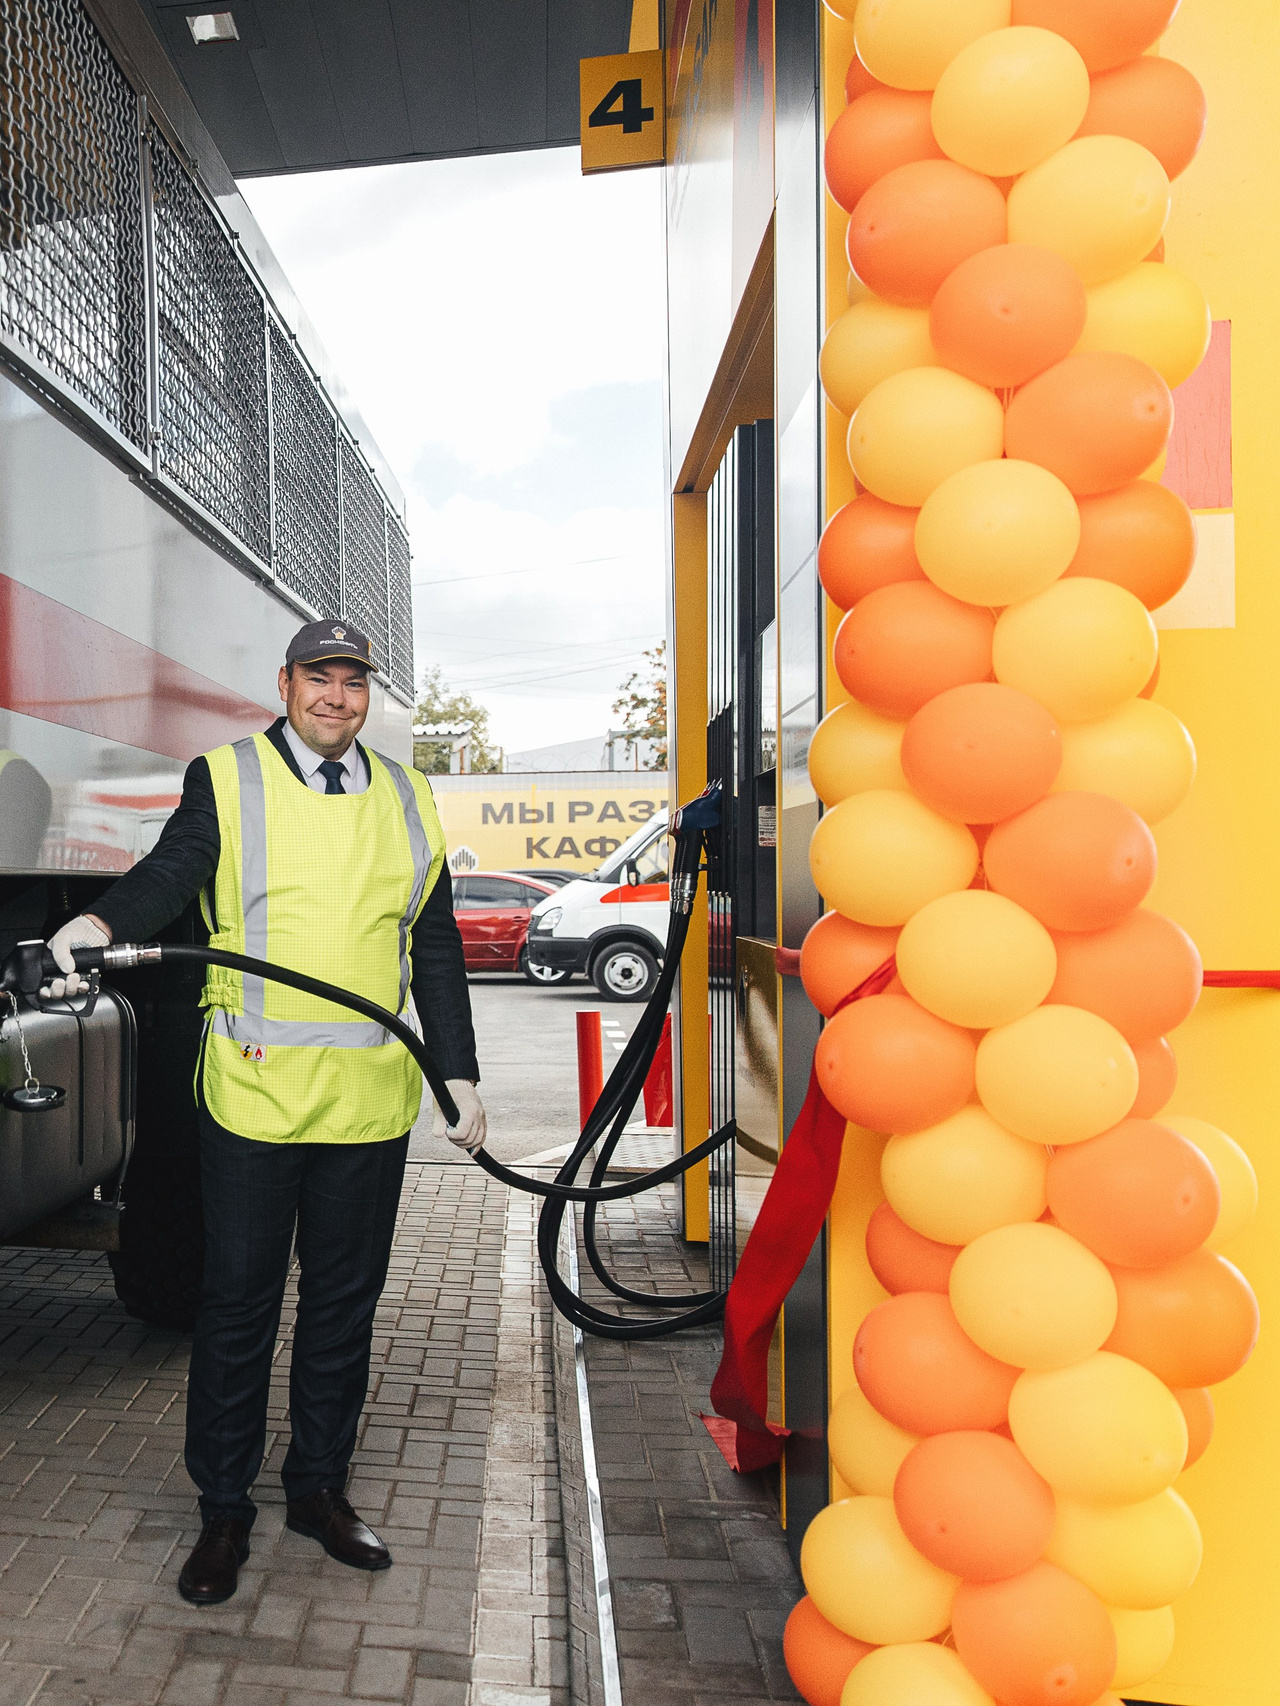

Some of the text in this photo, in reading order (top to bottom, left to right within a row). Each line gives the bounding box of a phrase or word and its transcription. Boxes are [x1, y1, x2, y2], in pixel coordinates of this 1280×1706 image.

[589, 78, 654, 134] 4
[481, 800, 668, 825] МЫ РАЗ
[526, 835, 632, 859] КАФ
